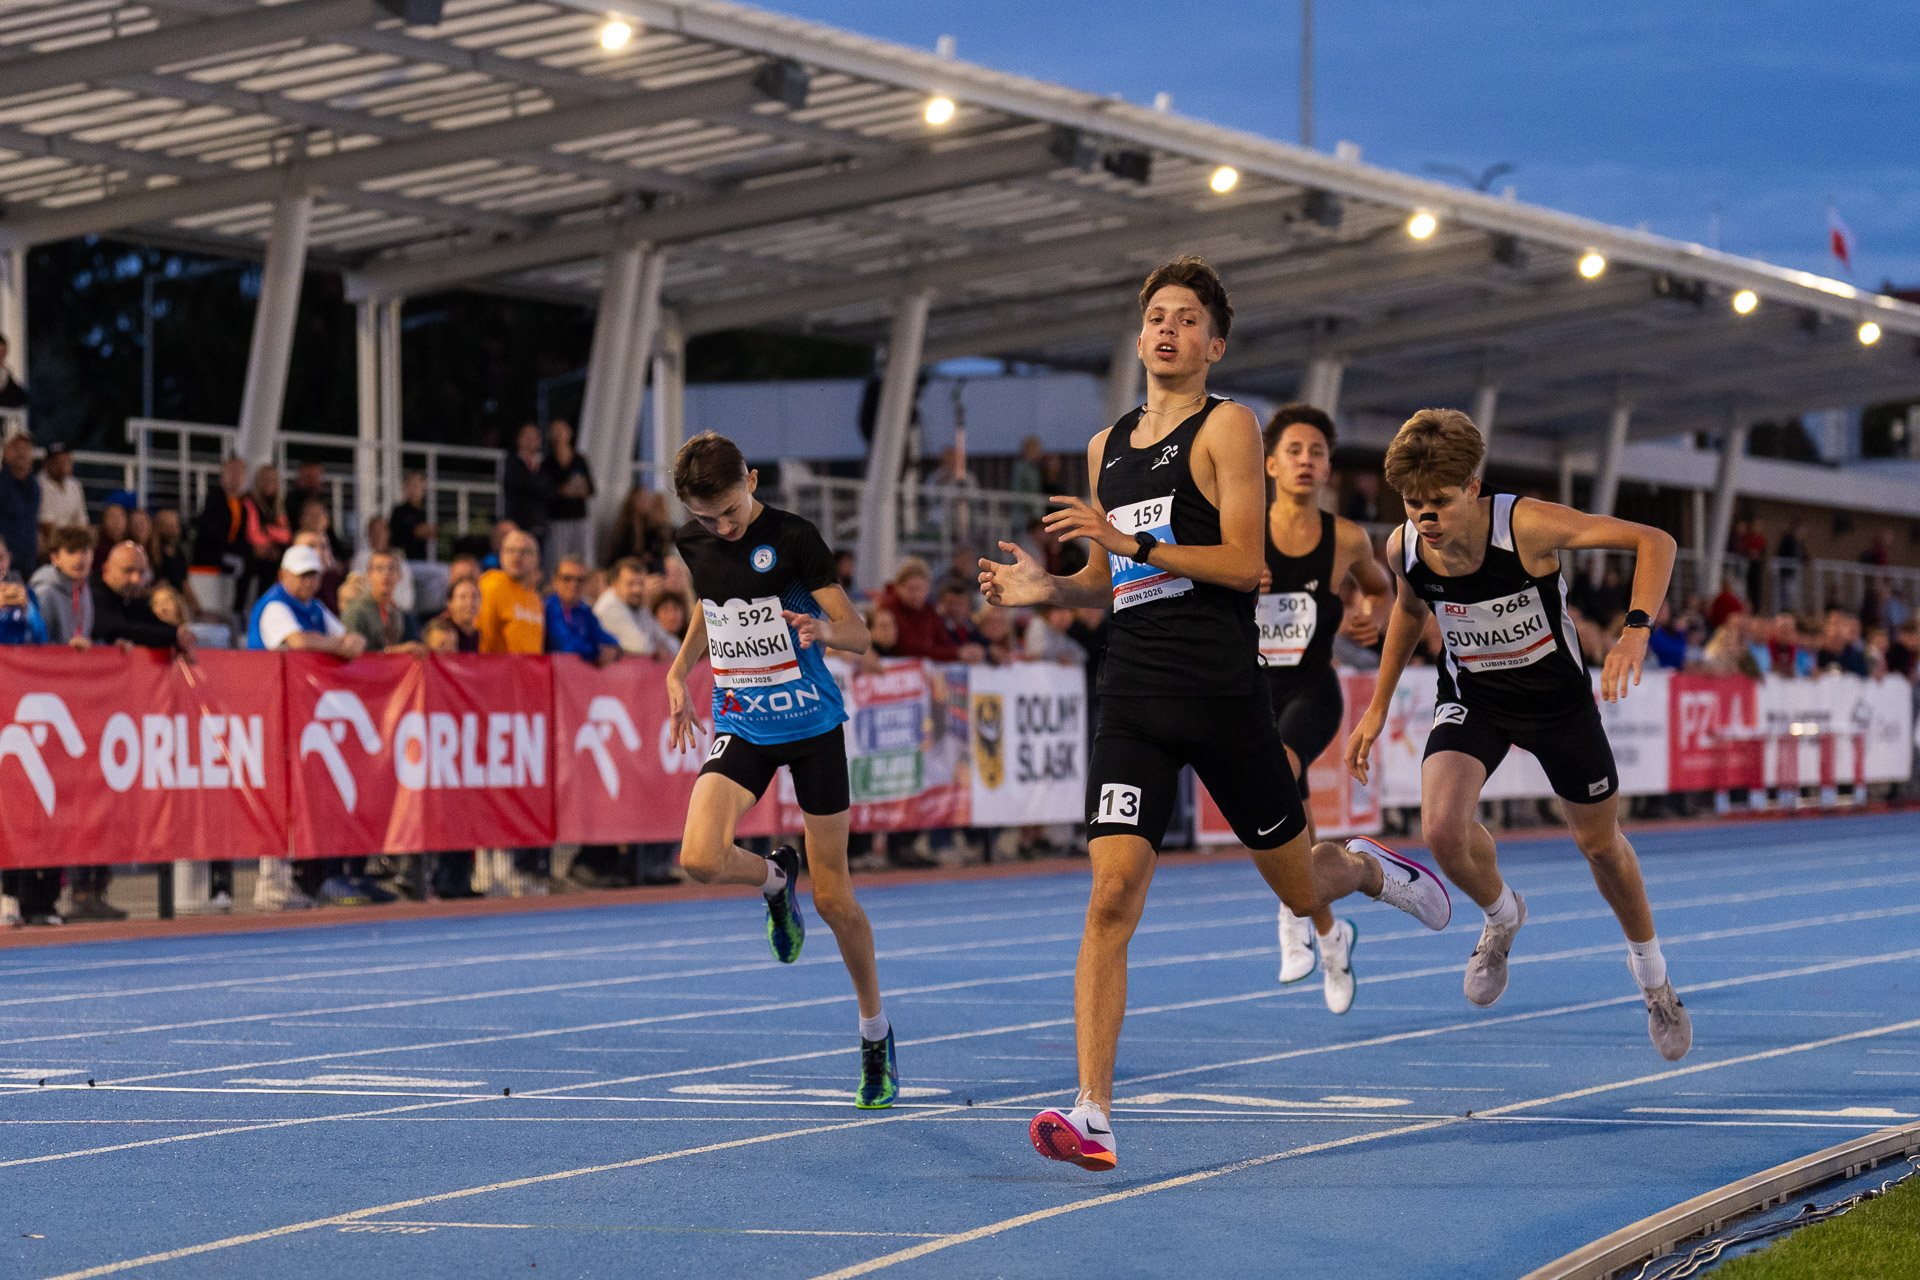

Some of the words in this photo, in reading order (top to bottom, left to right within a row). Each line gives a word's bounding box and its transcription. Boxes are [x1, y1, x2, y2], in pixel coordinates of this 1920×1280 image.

[1133, 503, 1163, 528] 159
[1120, 592, 1142, 605] LUBIN
[1143, 587, 1163, 599] 2026
[1278, 598, 1307, 613] 501
[1491, 594, 1531, 618] 968
[738, 606, 775, 627] 592
[1259, 623, 1312, 643] RĄGŁY
[1447, 614, 1543, 647] SUWALSKI
[710, 633, 789, 659] BUGAŃSKI
[1480, 660, 1506, 668] LUBIN
[1508, 656, 1530, 666] 2026
[732, 675, 753, 684] LUBIN
[720, 683, 821, 716] AXON
[99, 711, 266, 793] ORLEN
[394, 711, 547, 791] ORLEN
[1102, 789, 1138, 818] 13
